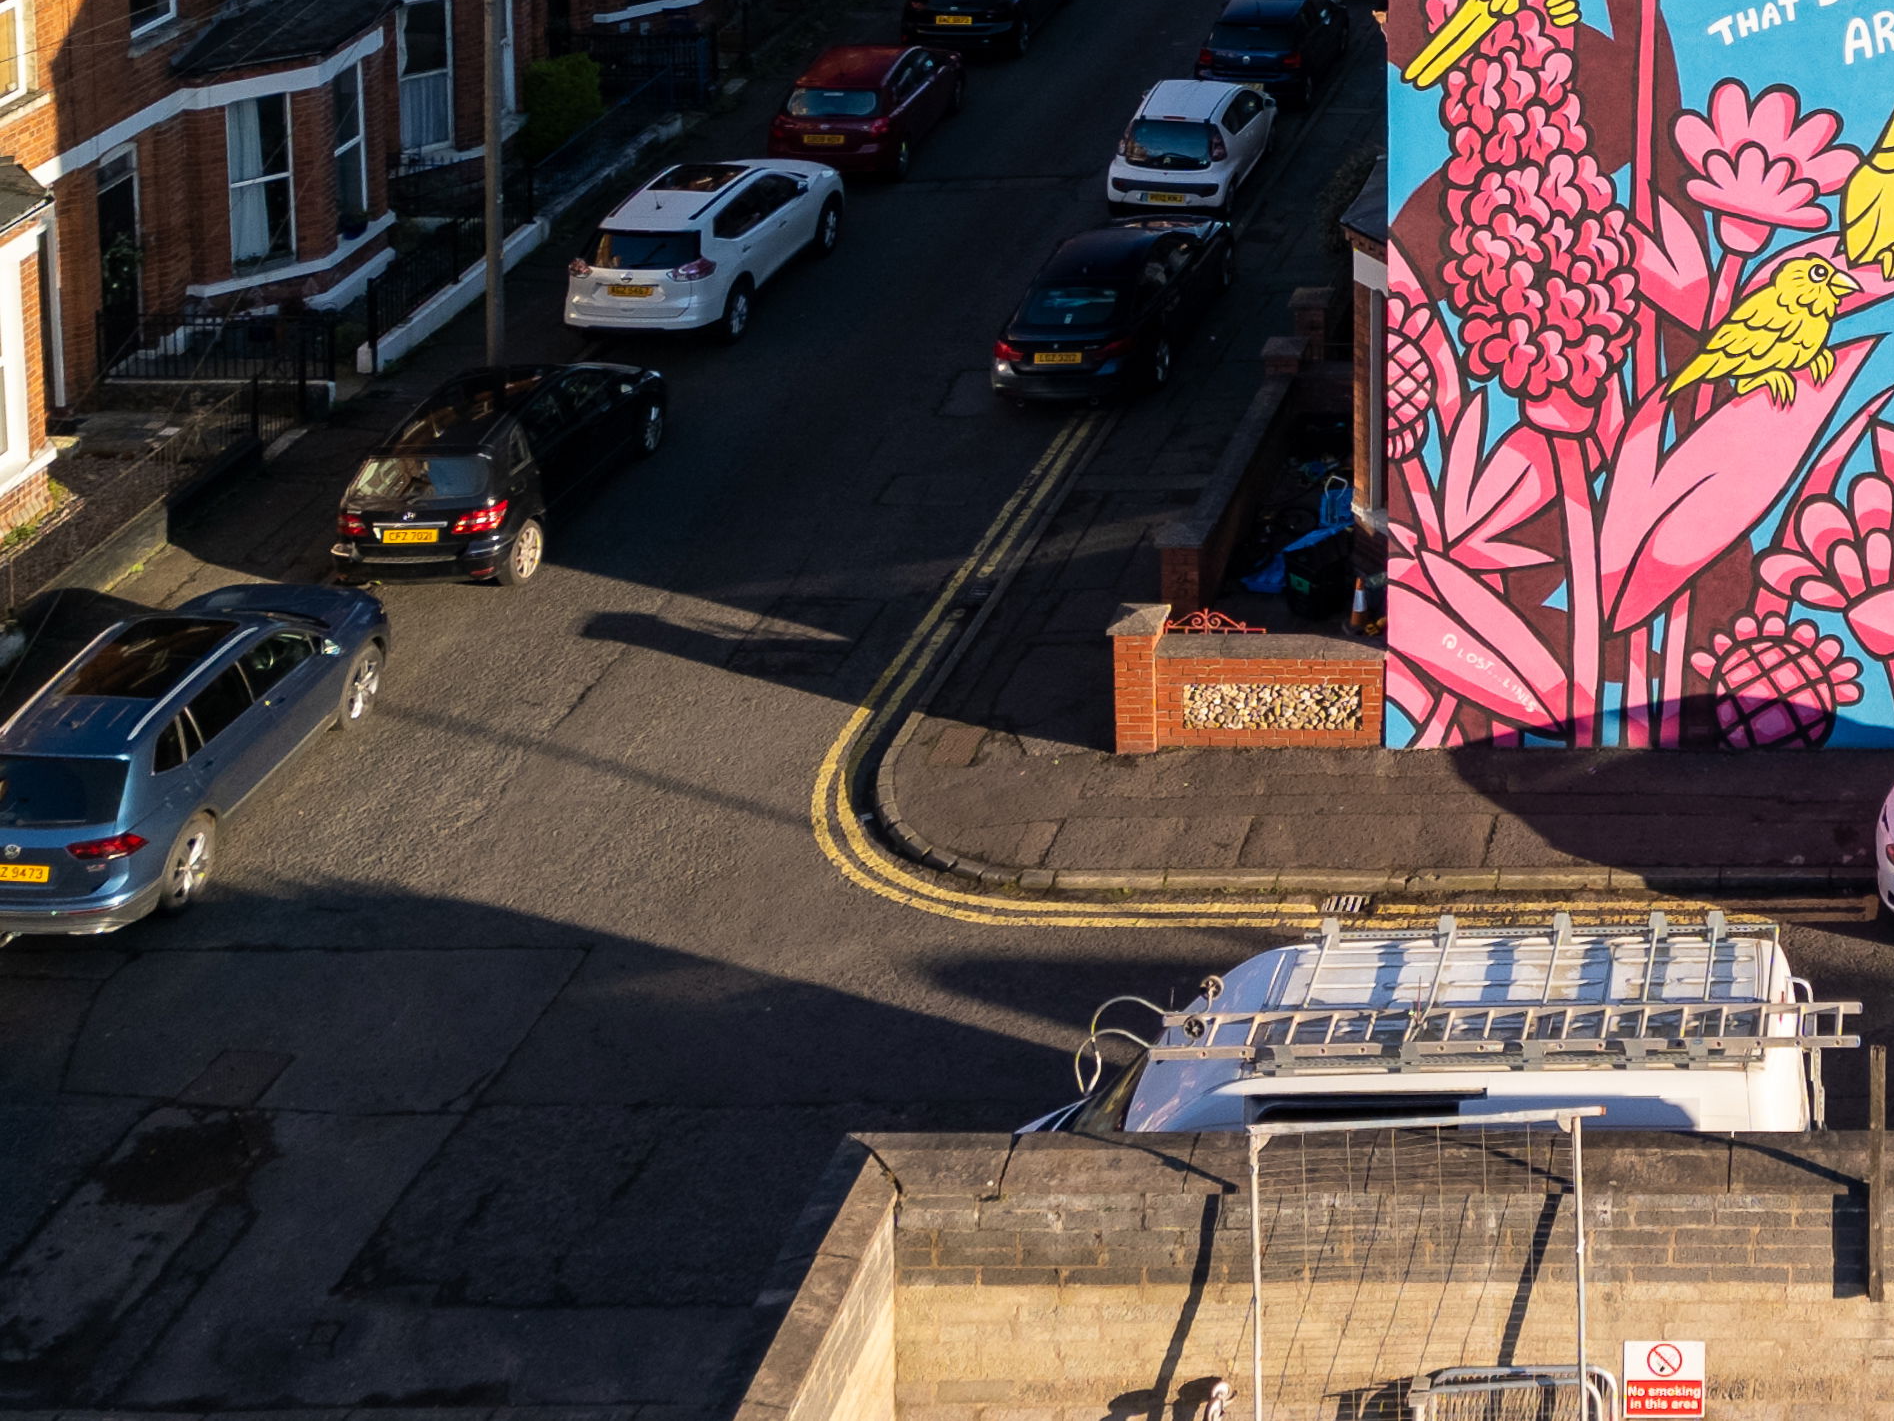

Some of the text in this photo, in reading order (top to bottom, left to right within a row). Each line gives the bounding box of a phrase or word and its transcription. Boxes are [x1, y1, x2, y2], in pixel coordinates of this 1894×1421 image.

[388, 532, 408, 542] CFZ
[12, 866, 44, 879] 9473
[1627, 1385, 1701, 1400] No smoking
[1630, 1398, 1699, 1410] in this area
